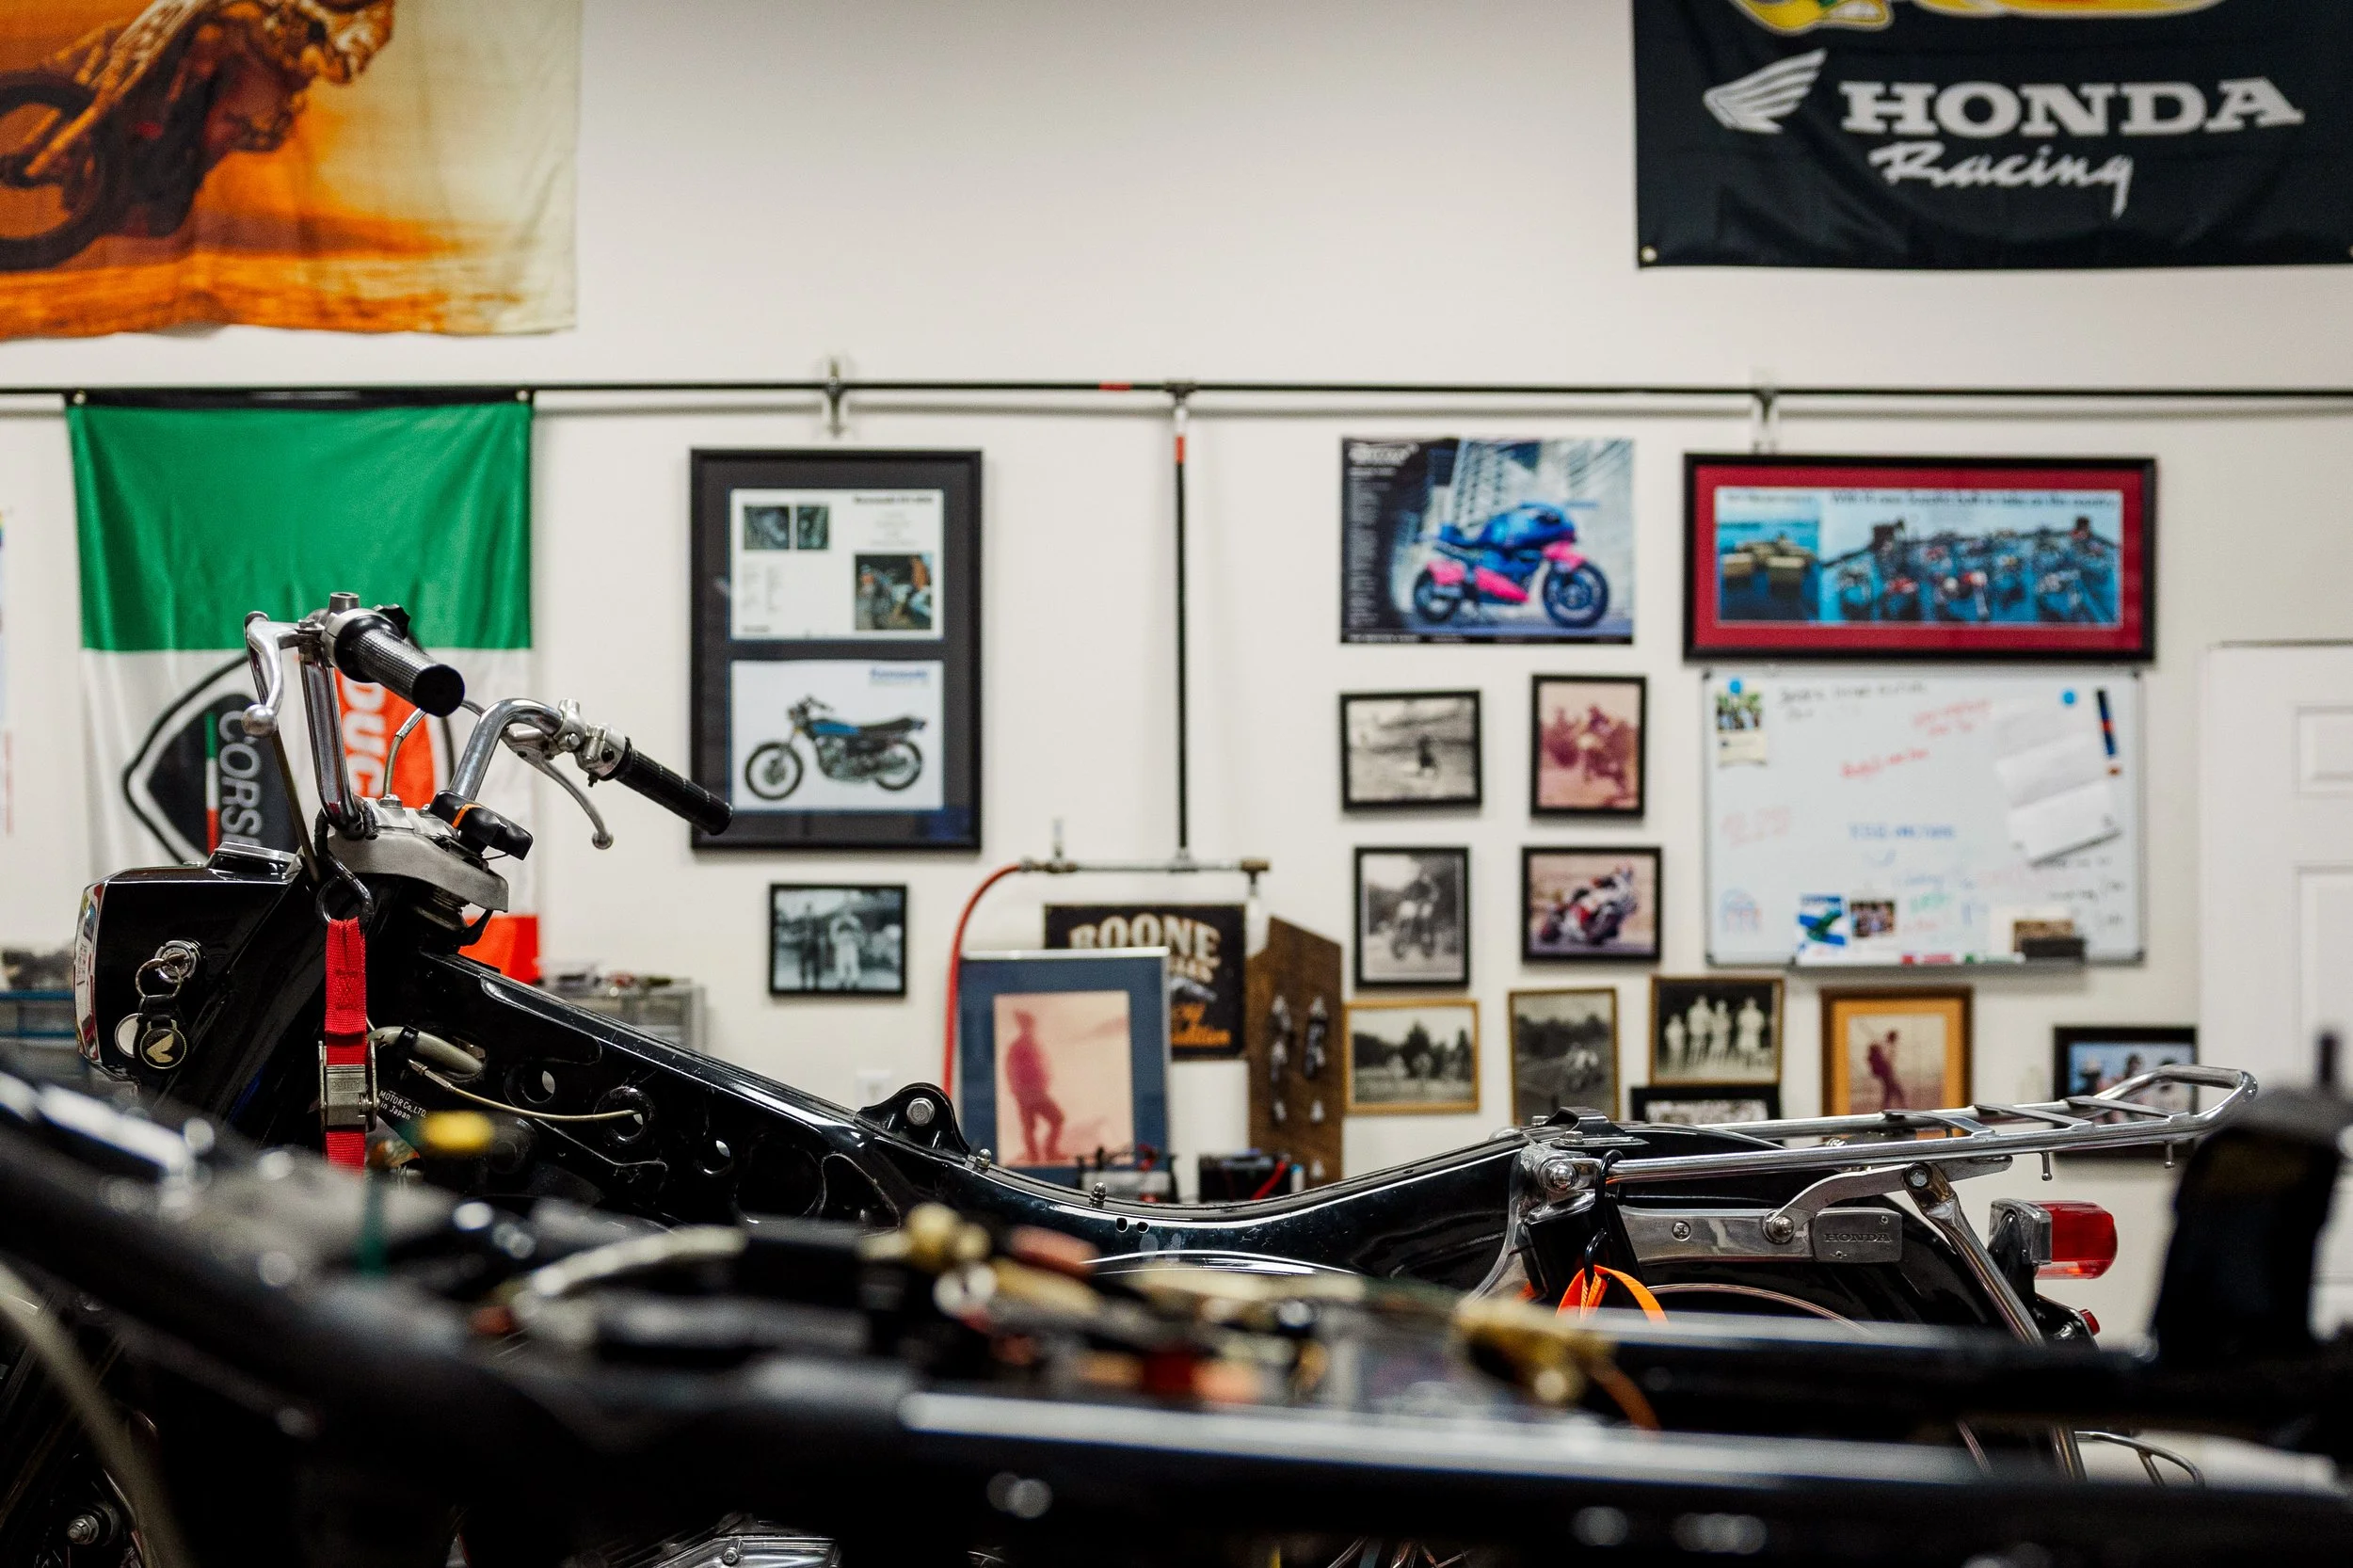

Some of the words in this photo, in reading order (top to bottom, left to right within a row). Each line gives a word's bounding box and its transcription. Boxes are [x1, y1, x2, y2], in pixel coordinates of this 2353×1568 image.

[1839, 77, 2305, 137] HONDA
[1868, 140, 2134, 219] Racing
[1070, 913, 1222, 968] BOONE
[378, 1090, 404, 1107] MOTOR
[380, 1101, 388, 1110] in
[389, 1105, 411, 1120] Japan
[1824, 1233, 1892, 1243] HONDA
